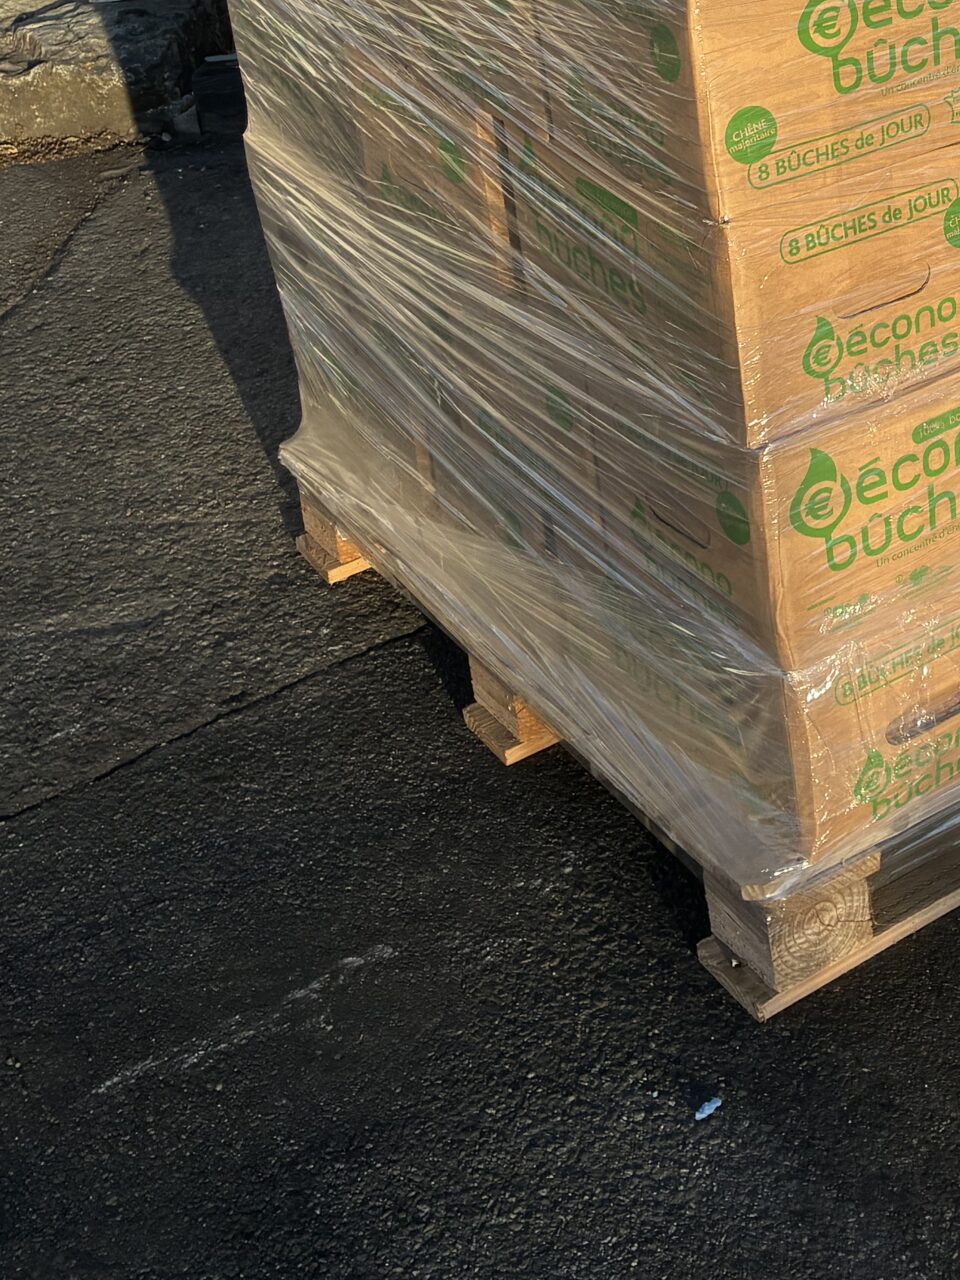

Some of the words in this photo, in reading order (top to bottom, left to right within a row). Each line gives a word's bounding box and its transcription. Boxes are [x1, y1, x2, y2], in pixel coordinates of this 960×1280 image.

[729, 128, 776, 155] majoritaire
[732, 117, 768, 142] CHÊNE
[757, 163, 770, 182] 8
[774, 137, 850, 178] BÛCHES
[854, 128, 875, 150] de
[878, 112, 924, 150] JOUR
[788, 238, 800, 258] 8
[804, 210, 878, 252] BÛCHES
[882, 204, 902, 225] de
[906, 186, 951, 220] JOUR
[846, 296, 957, 357] écono
[824, 329, 960, 403] bûches
[876, 555, 890, 568] Un
